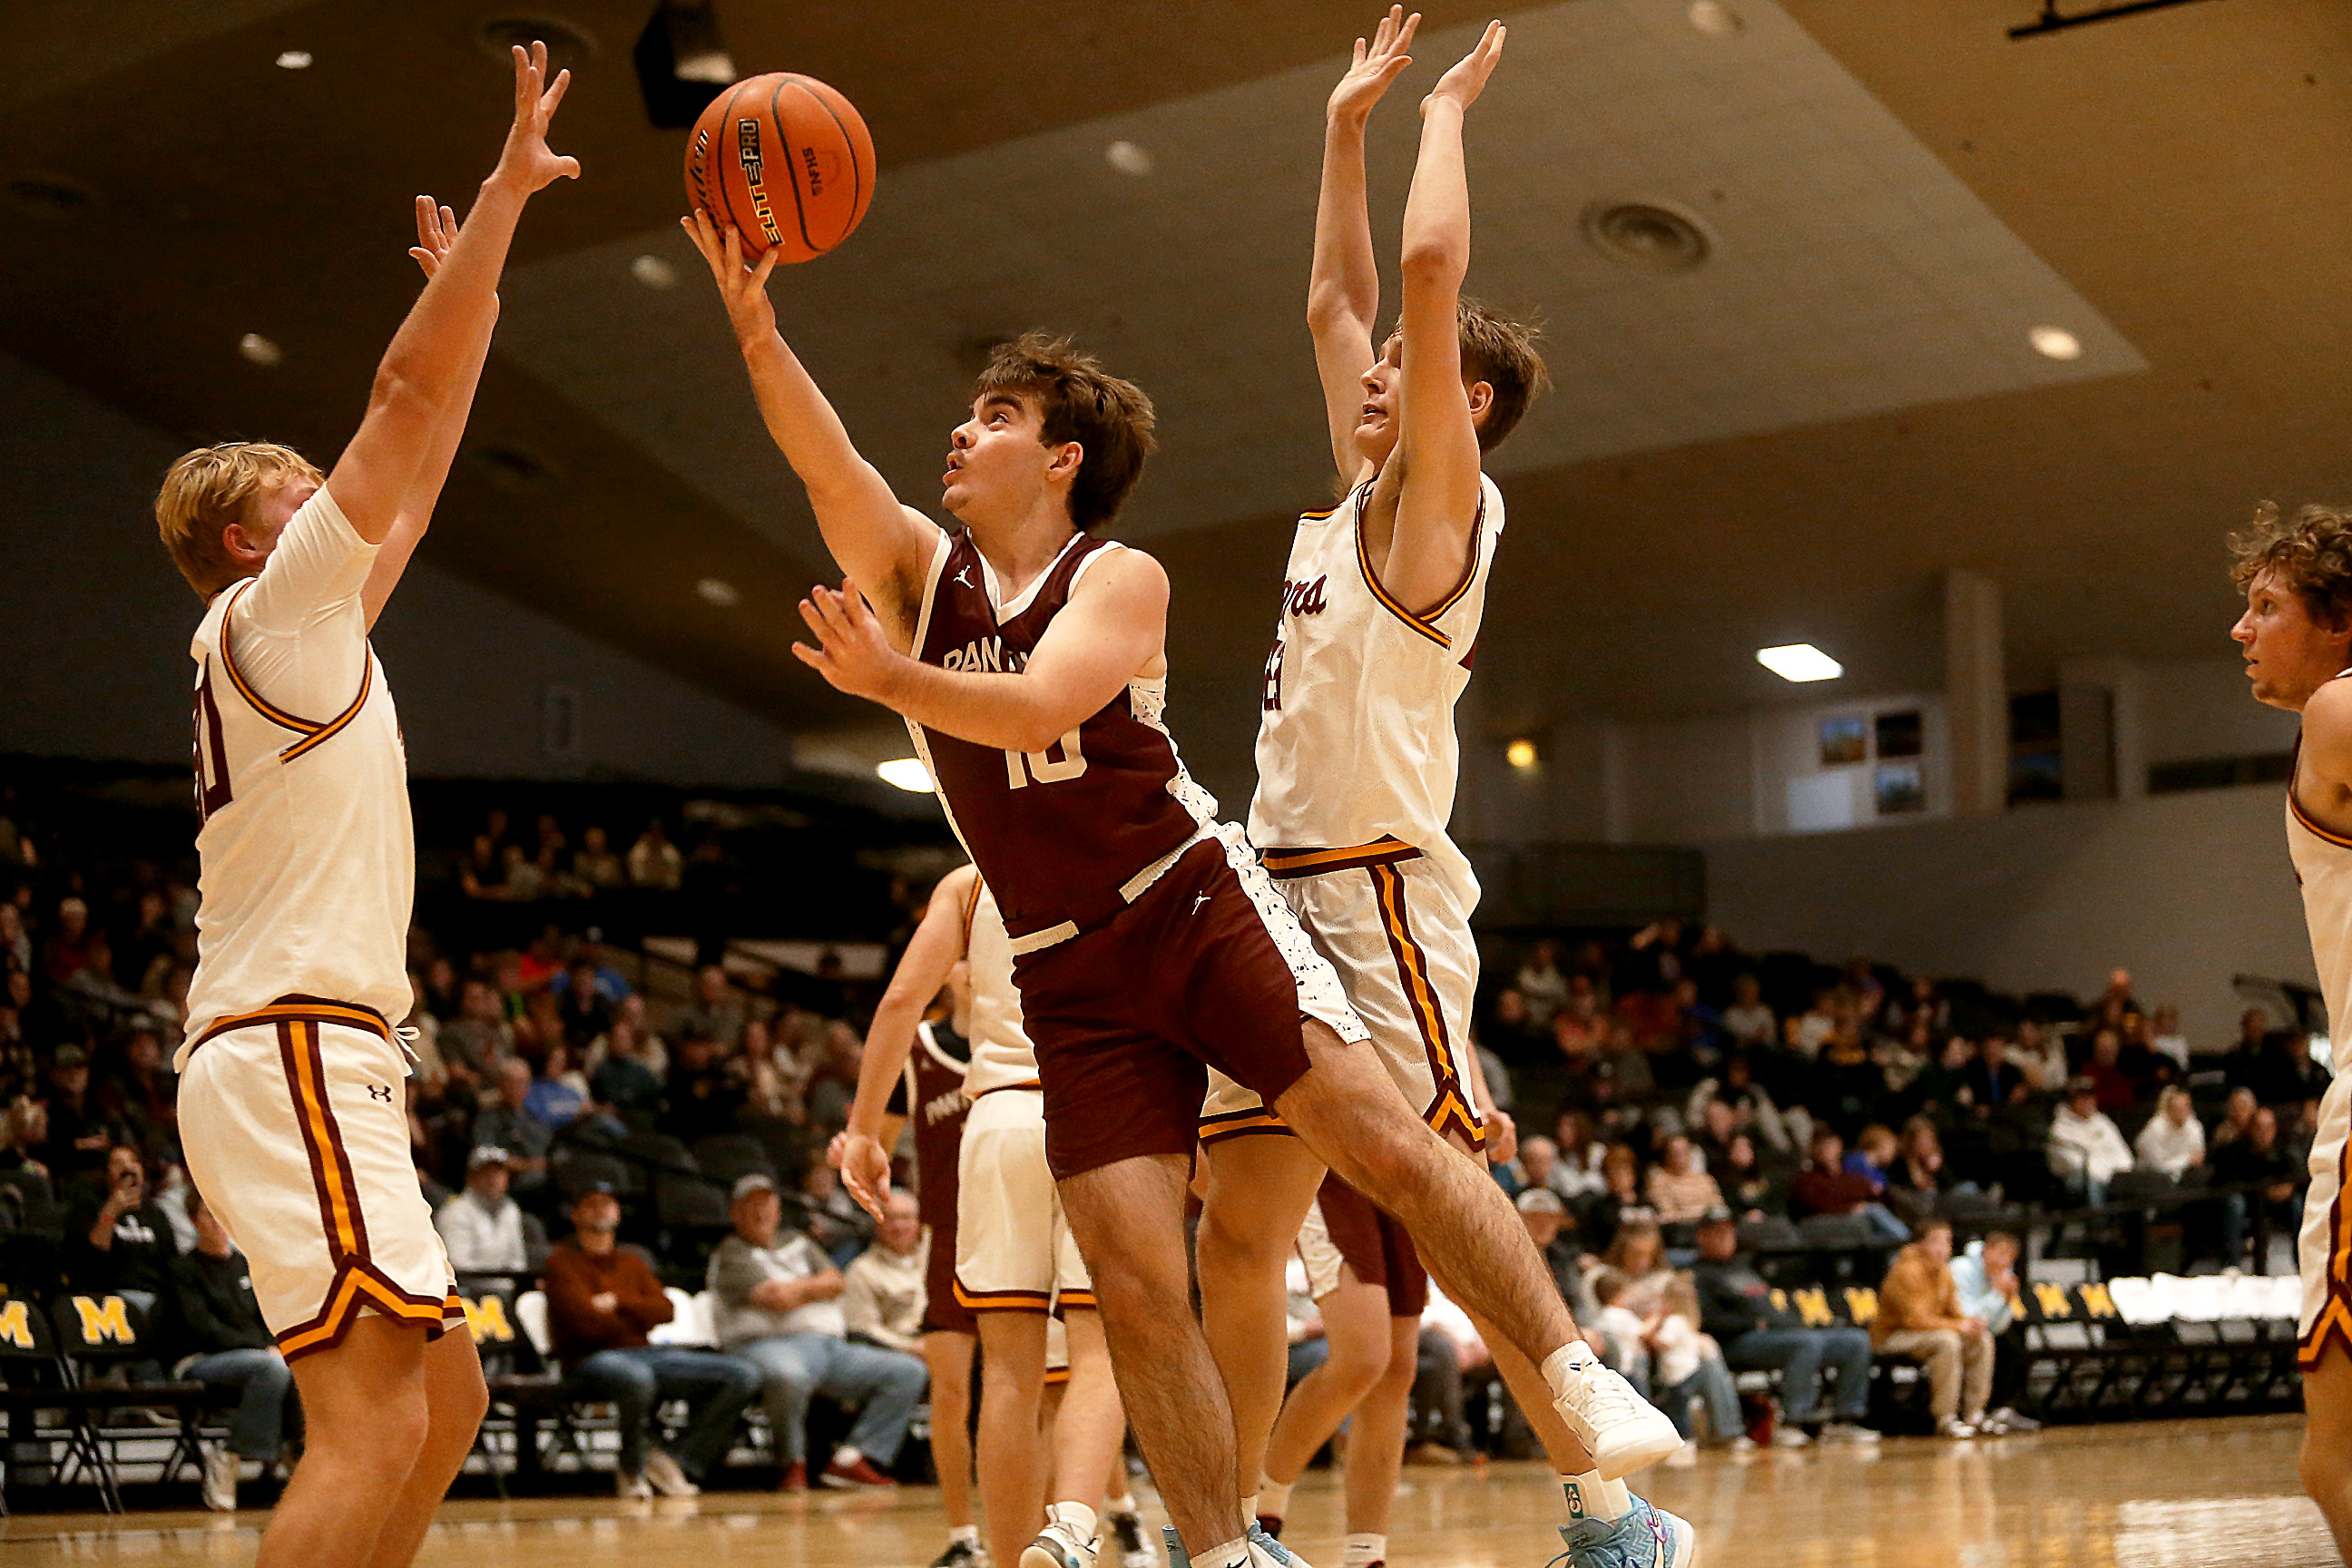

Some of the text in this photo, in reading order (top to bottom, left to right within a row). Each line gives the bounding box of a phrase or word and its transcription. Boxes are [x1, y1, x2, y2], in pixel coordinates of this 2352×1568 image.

[739, 120, 785, 245] ELITE PRO
[944, 635, 1028, 672] PAN
[72, 1295, 135, 1345] M
